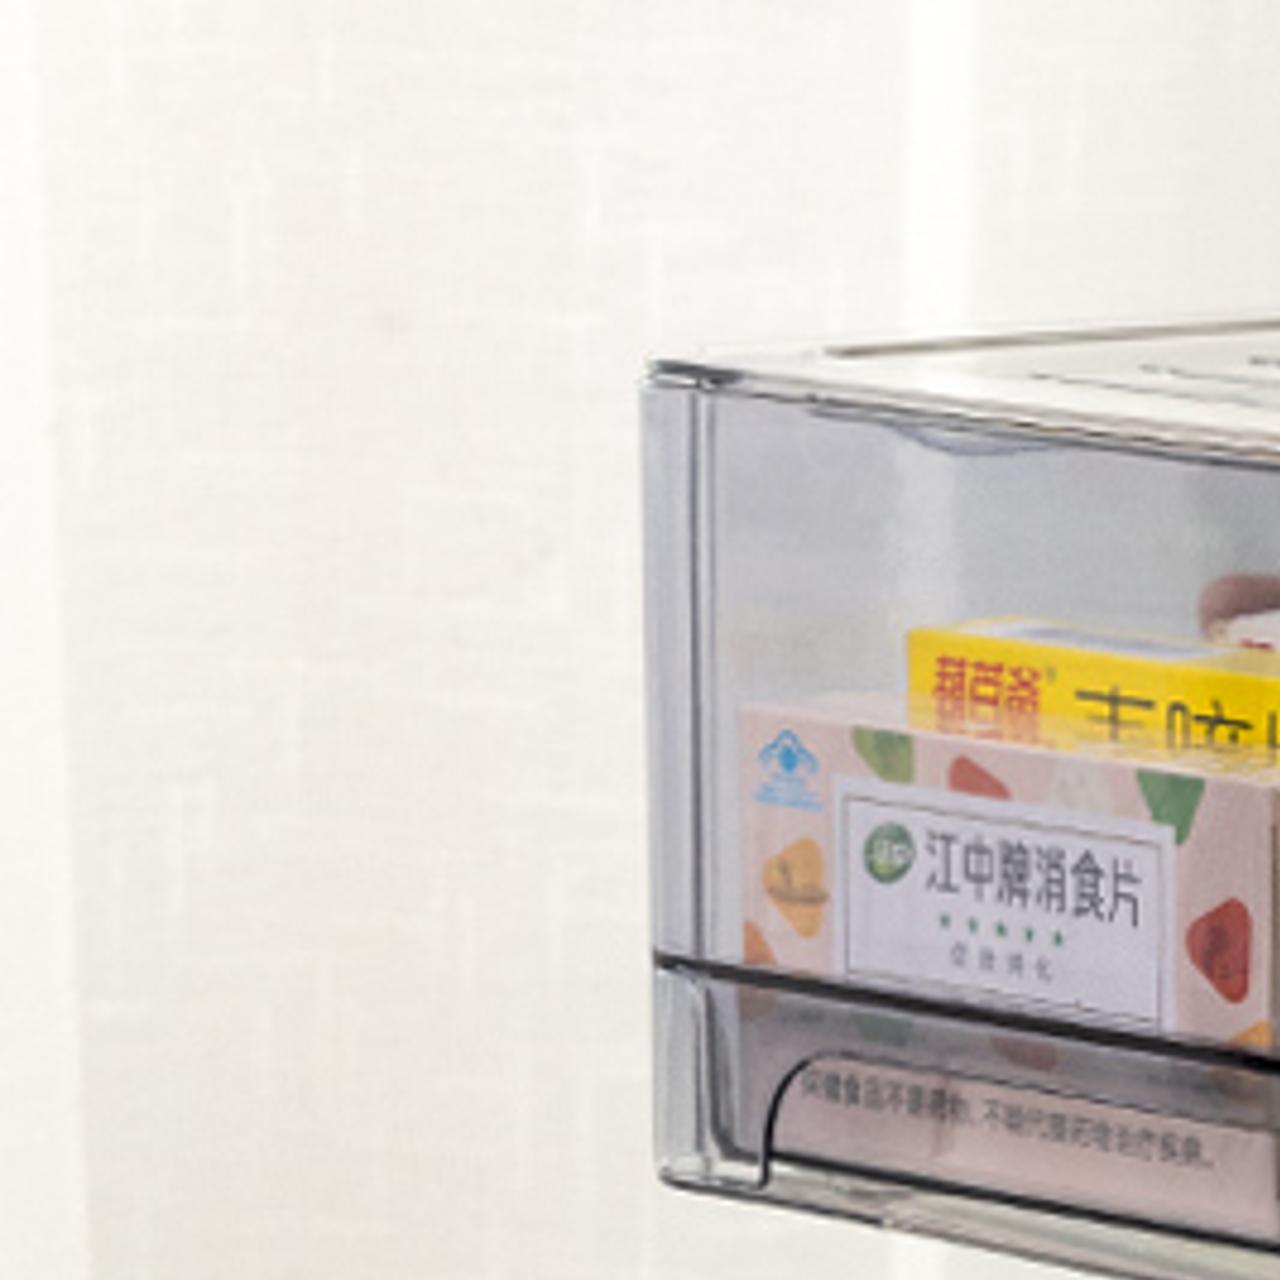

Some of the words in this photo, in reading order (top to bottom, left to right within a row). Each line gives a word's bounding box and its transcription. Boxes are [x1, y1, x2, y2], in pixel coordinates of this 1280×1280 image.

[925, 828, 1143, 927] 江中牌消食片
